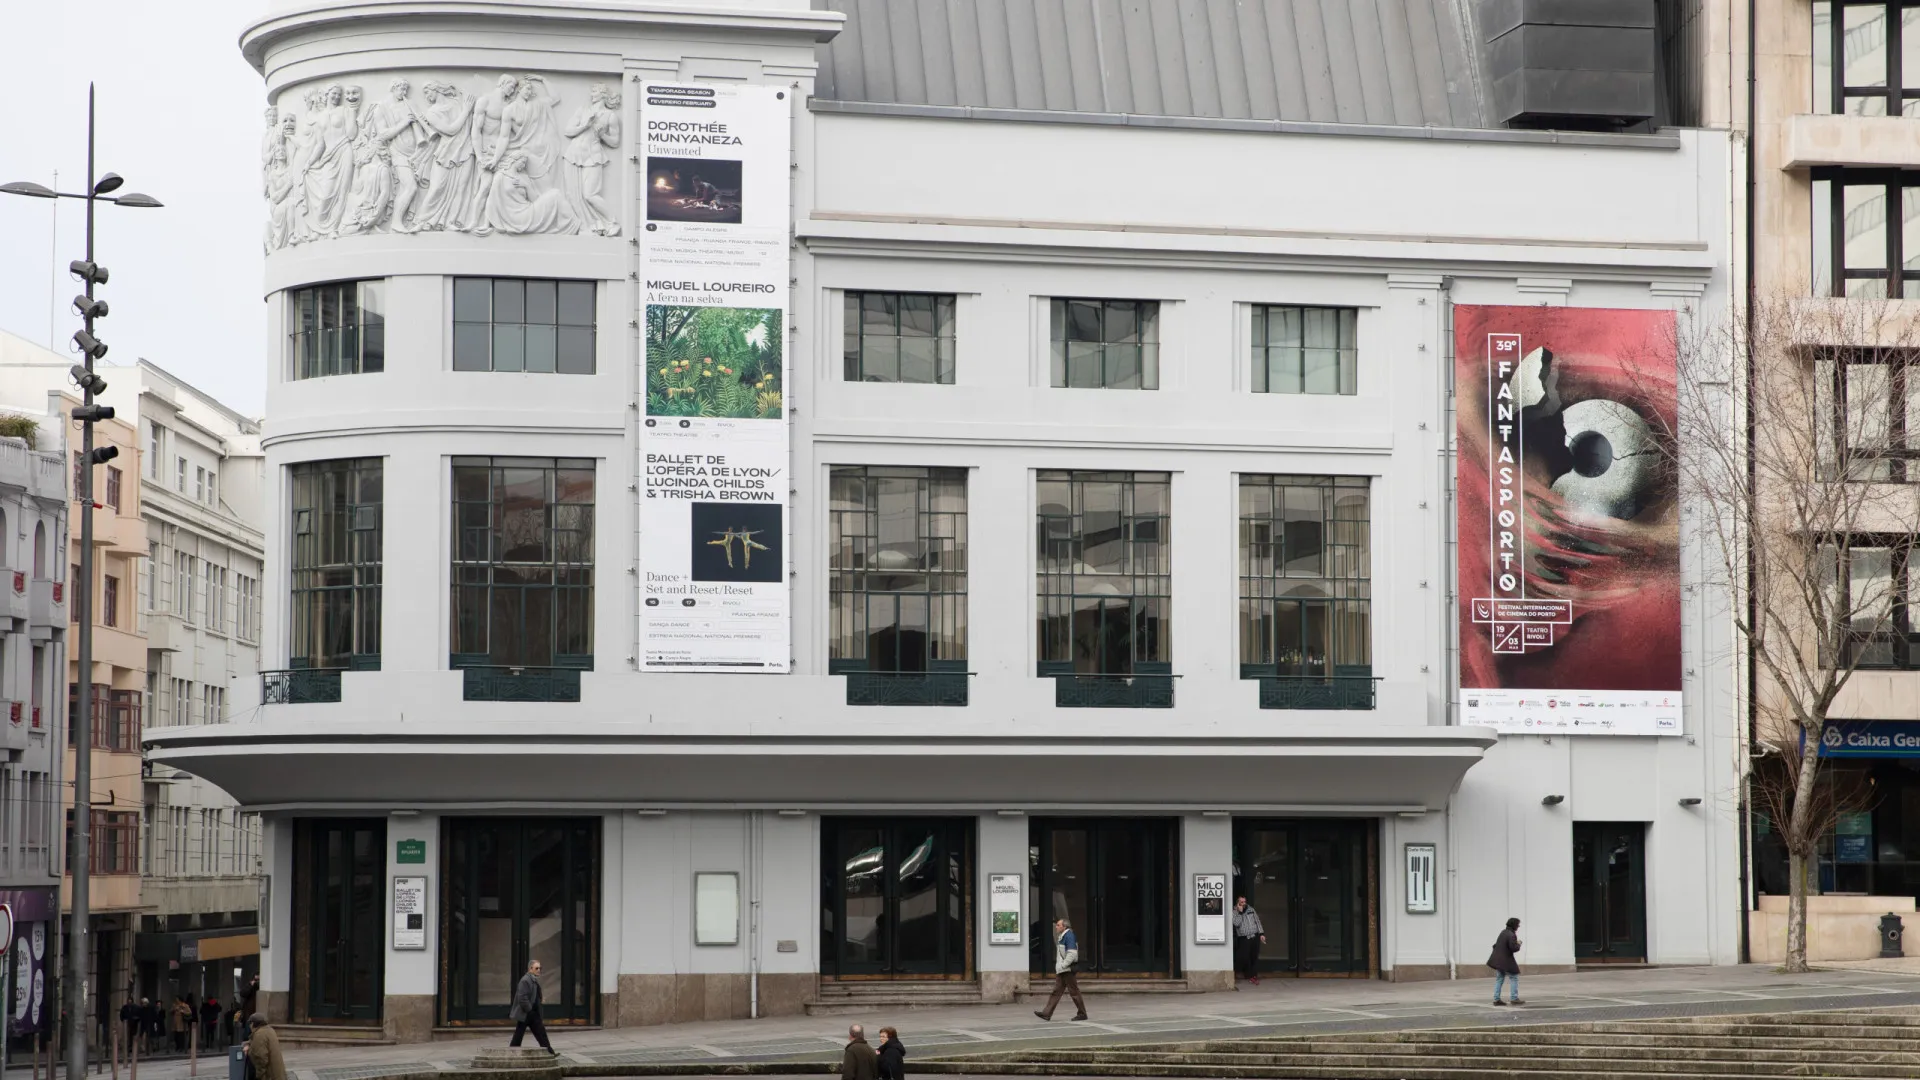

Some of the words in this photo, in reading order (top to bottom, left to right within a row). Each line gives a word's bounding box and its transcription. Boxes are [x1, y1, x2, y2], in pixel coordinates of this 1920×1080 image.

[648, 121, 727, 133] DOROTHÉE
[648, 133, 742, 145] MUNYANEZA
[648, 145, 701, 156] Unwanted
[647, 280, 699, 291] MIGUEL
[704, 282, 775, 293] LOUREIRO
[647, 292, 655, 302] A
[658, 293, 678, 302] fera
[681, 295, 694, 303] na
[697, 294, 723, 304] selva
[647, 454, 703, 464] BALLET
[707, 456, 725, 464] DE
[646, 464, 707, 476] L'OPÉRA
[712, 467, 729, 476] DE
[734, 468, 781, 477] LYON/
[1497, 361, 1516, 592] FANTASPORTO
[646, 478, 709, 488] LUCINDA
[714, 480, 764, 489] CHILDS
[647, 490, 656, 498] &
[660, 490, 715, 499] TRISHA
[720, 491, 774, 500] BROWN
[646, 572, 679, 582] Dance
[646, 585, 663, 594] Set
[667, 585, 686, 594] and
[690, 585, 753, 595] Reset/Reset
[1848, 733, 1890, 746] Caixa
[1198, 882, 1223, 890] MILO
